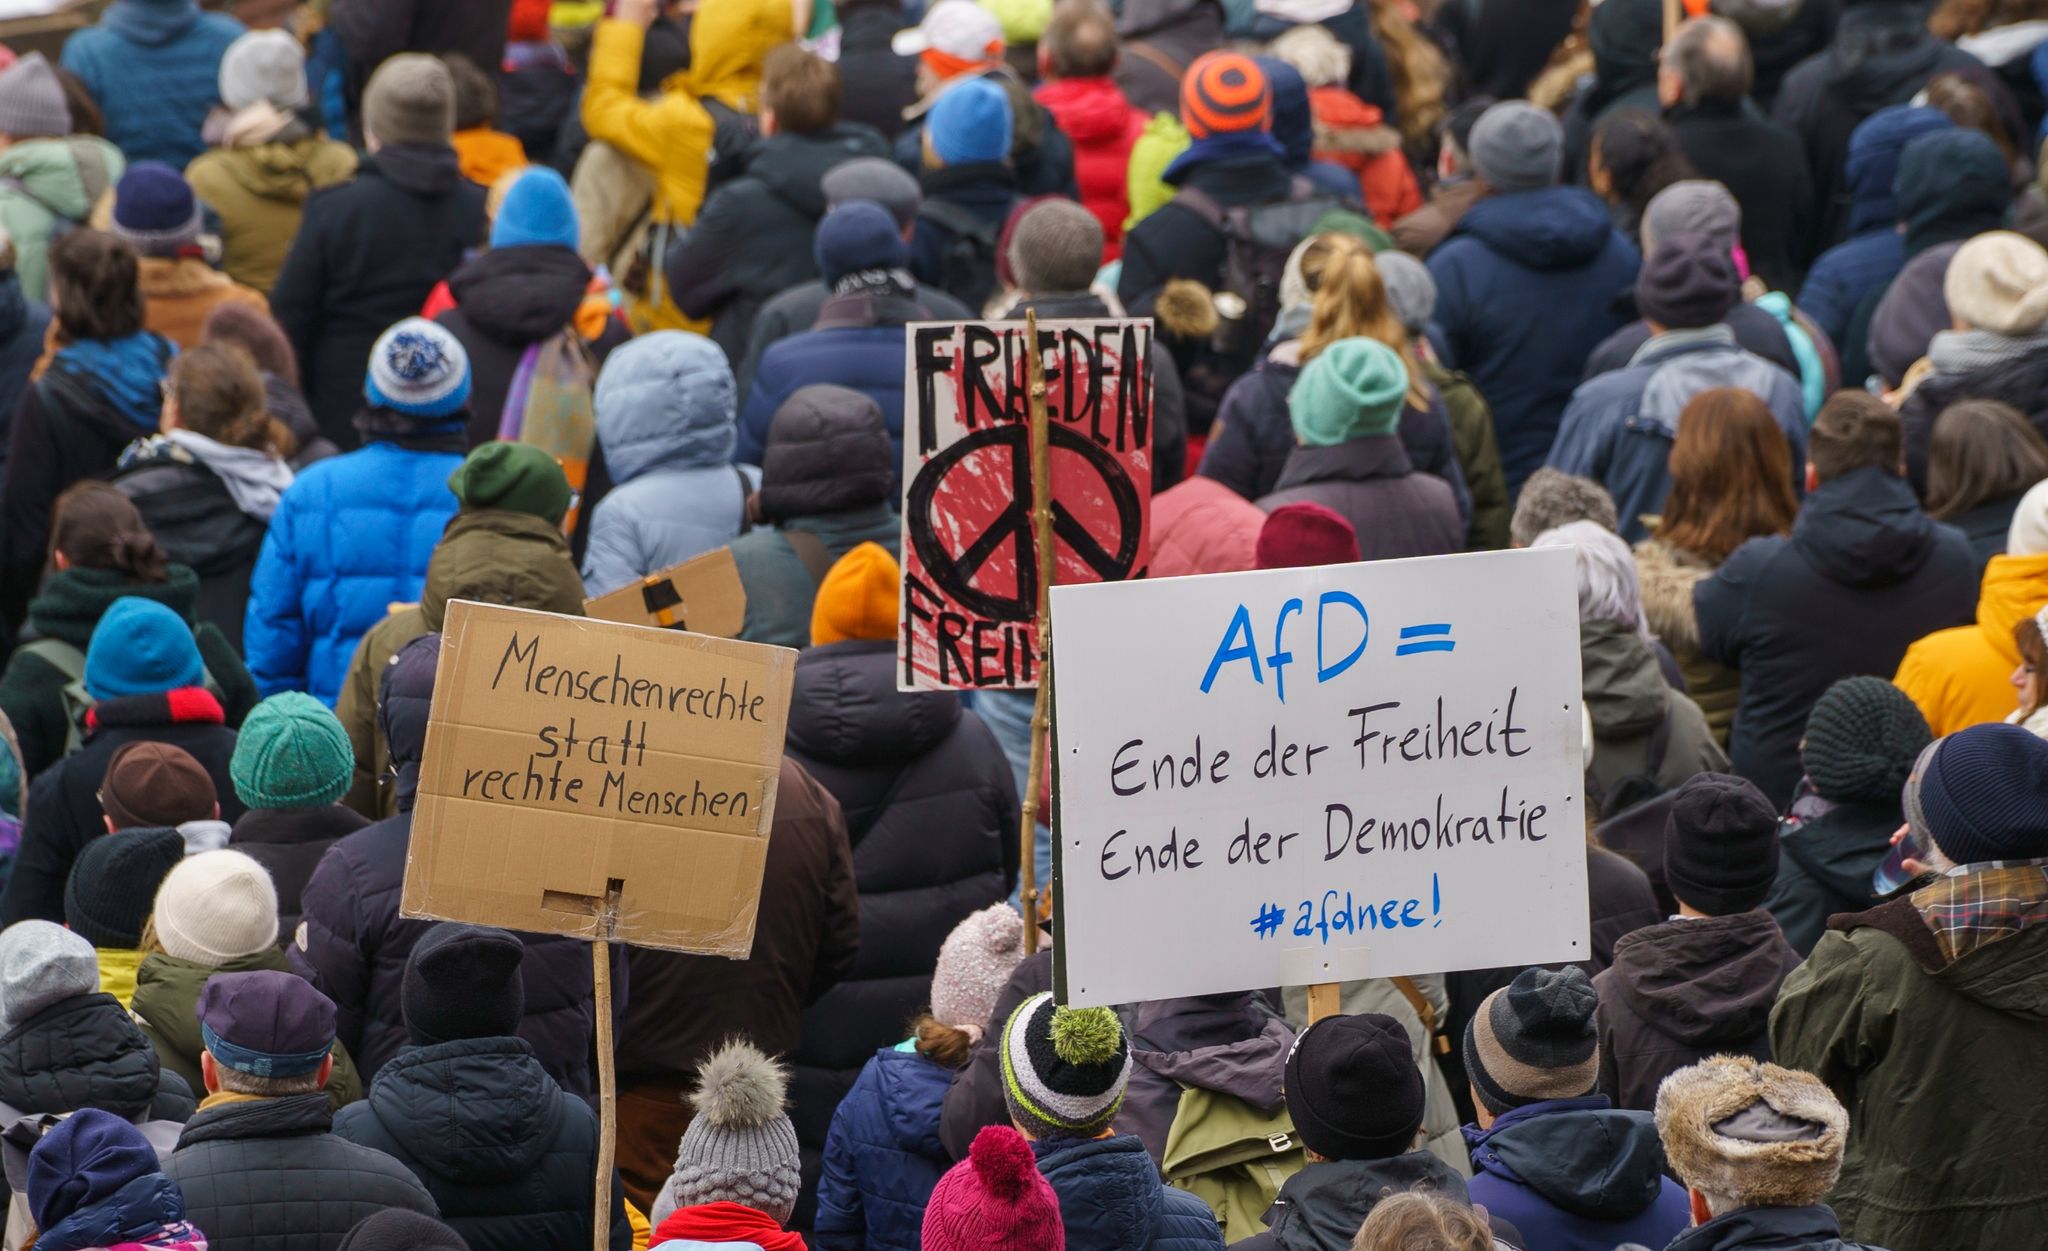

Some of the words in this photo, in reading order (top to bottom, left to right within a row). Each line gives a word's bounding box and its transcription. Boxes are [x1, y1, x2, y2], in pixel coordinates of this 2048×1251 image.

[905, 572, 1048, 686] FREIH
[1200, 591, 1368, 704] AfD
[1396, 623, 1456, 657] =
[492, 631, 764, 722] Menschenrechte
[463, 754, 583, 803] rechte
[599, 771, 747, 816] Menschen
[535, 717, 646, 767] statt
[1111, 736, 1232, 796] Ende
[1254, 725, 1329, 779] der
[1348, 686, 1532, 770] Freiheit
[1100, 827, 1204, 881] Ende
[1227, 817, 1300, 865] der
[1324, 785, 1548, 862] Demokratie
[1250, 872, 1441, 945] #afdnee!
